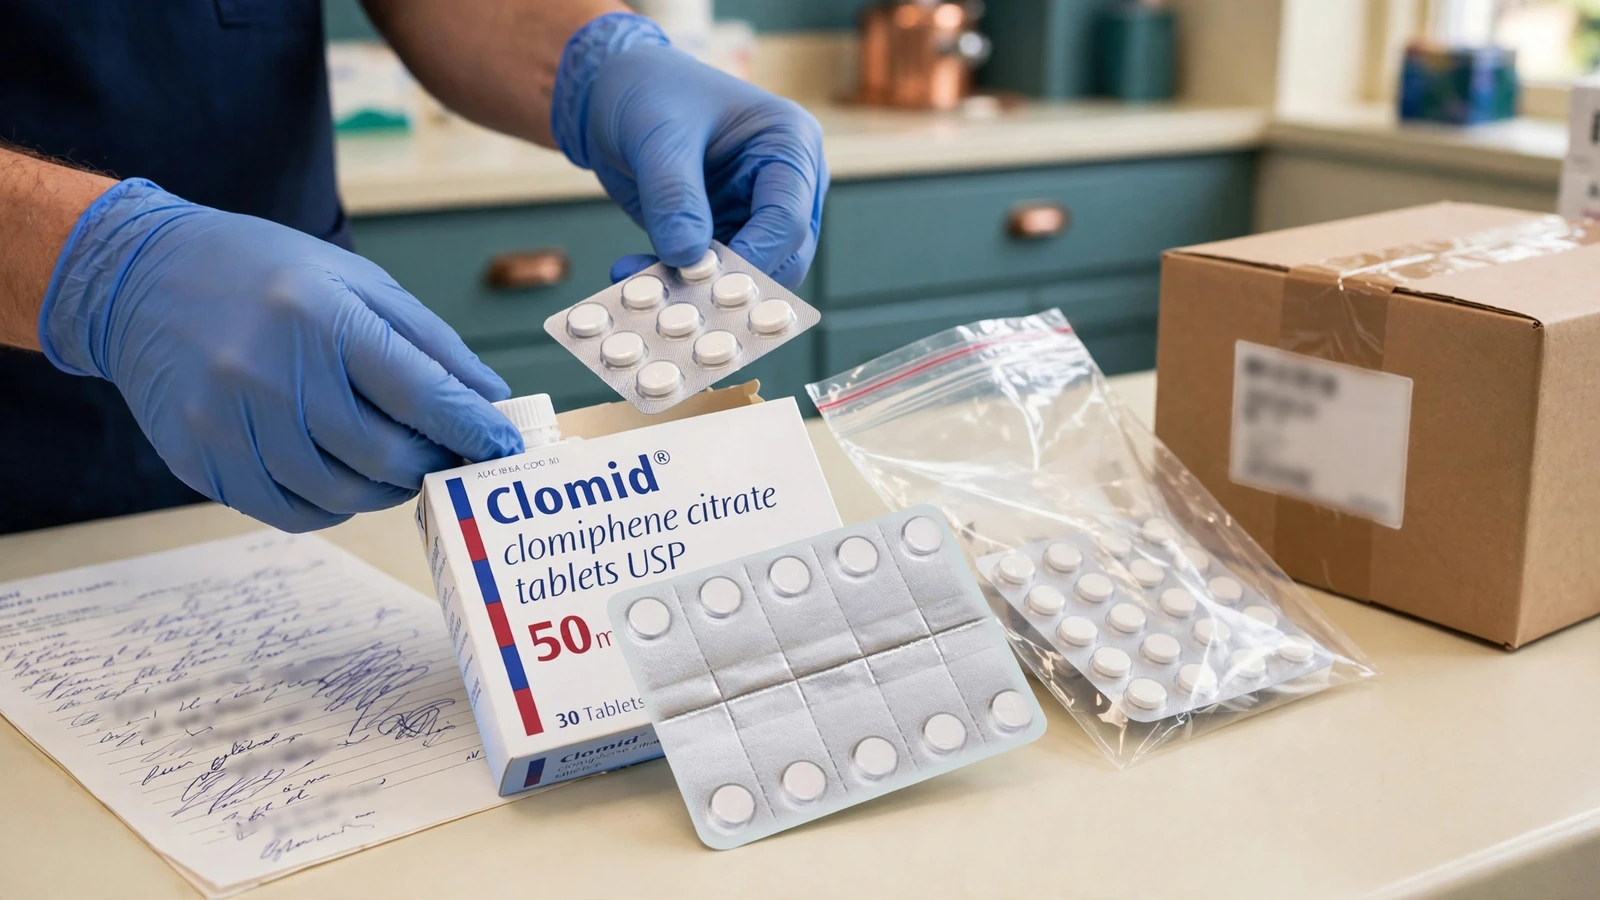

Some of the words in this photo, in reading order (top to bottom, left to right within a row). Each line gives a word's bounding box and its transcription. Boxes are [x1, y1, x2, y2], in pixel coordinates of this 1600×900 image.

[503, 509, 679, 566] clomiphene
[686, 486, 778, 526] citrate
[515, 563, 619, 604] tablets
[628, 541, 687, 579] USP
[527, 615, 612, 662] 50m
[555, 710, 580, 729] 30
[582, 697, 645, 722] Tablets
